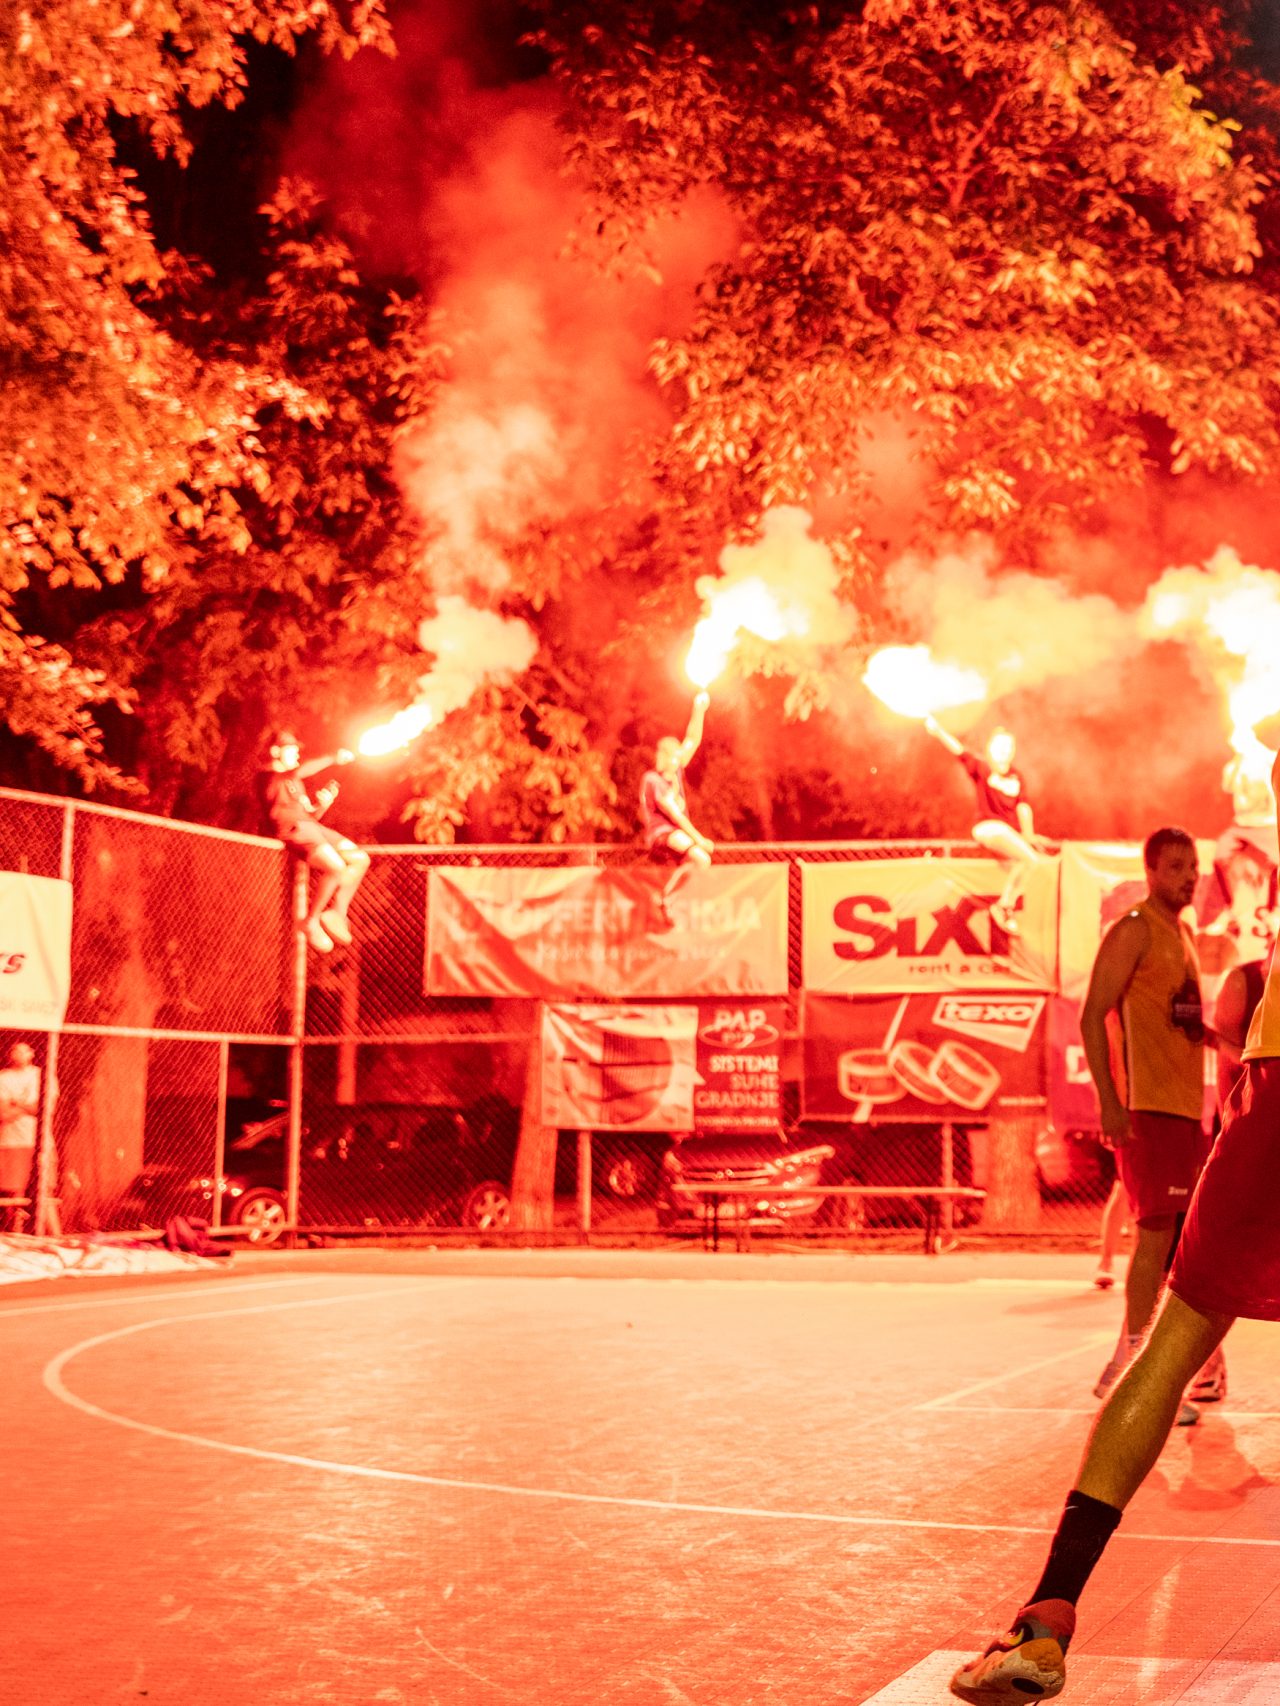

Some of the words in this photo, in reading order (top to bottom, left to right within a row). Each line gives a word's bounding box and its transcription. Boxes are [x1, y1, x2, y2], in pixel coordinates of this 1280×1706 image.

[710, 1054, 779, 1073] SISTEMI
[730, 1073, 779, 1090] SUHE
[695, 1090, 779, 1109] GRADNJE
